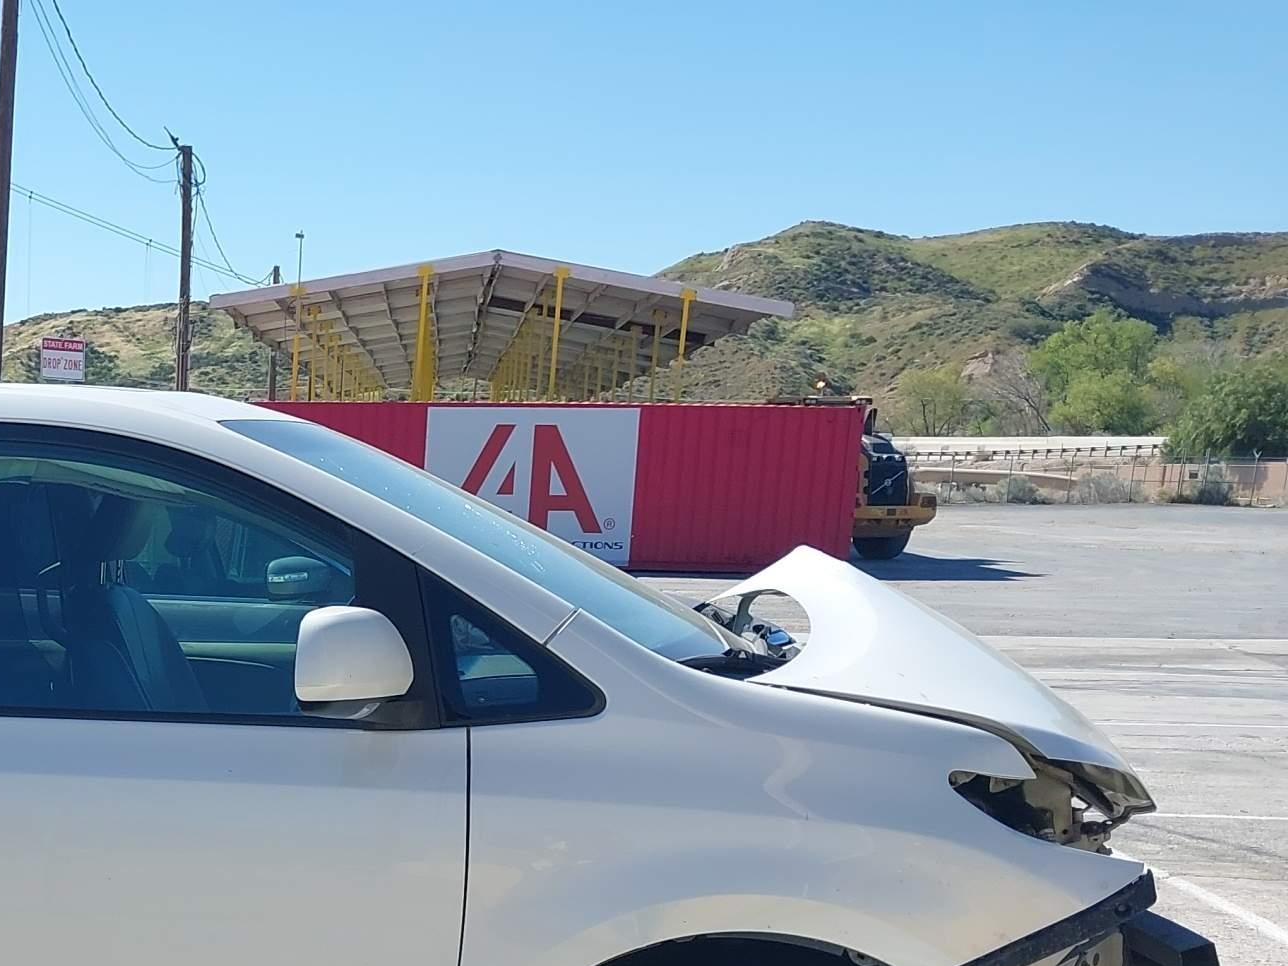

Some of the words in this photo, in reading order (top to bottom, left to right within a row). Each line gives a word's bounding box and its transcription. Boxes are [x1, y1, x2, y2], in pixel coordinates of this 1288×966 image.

[64, 342, 83, 350] FARM
[43, 357, 61, 369] DROP
[64, 359, 83, 371] ZONE
